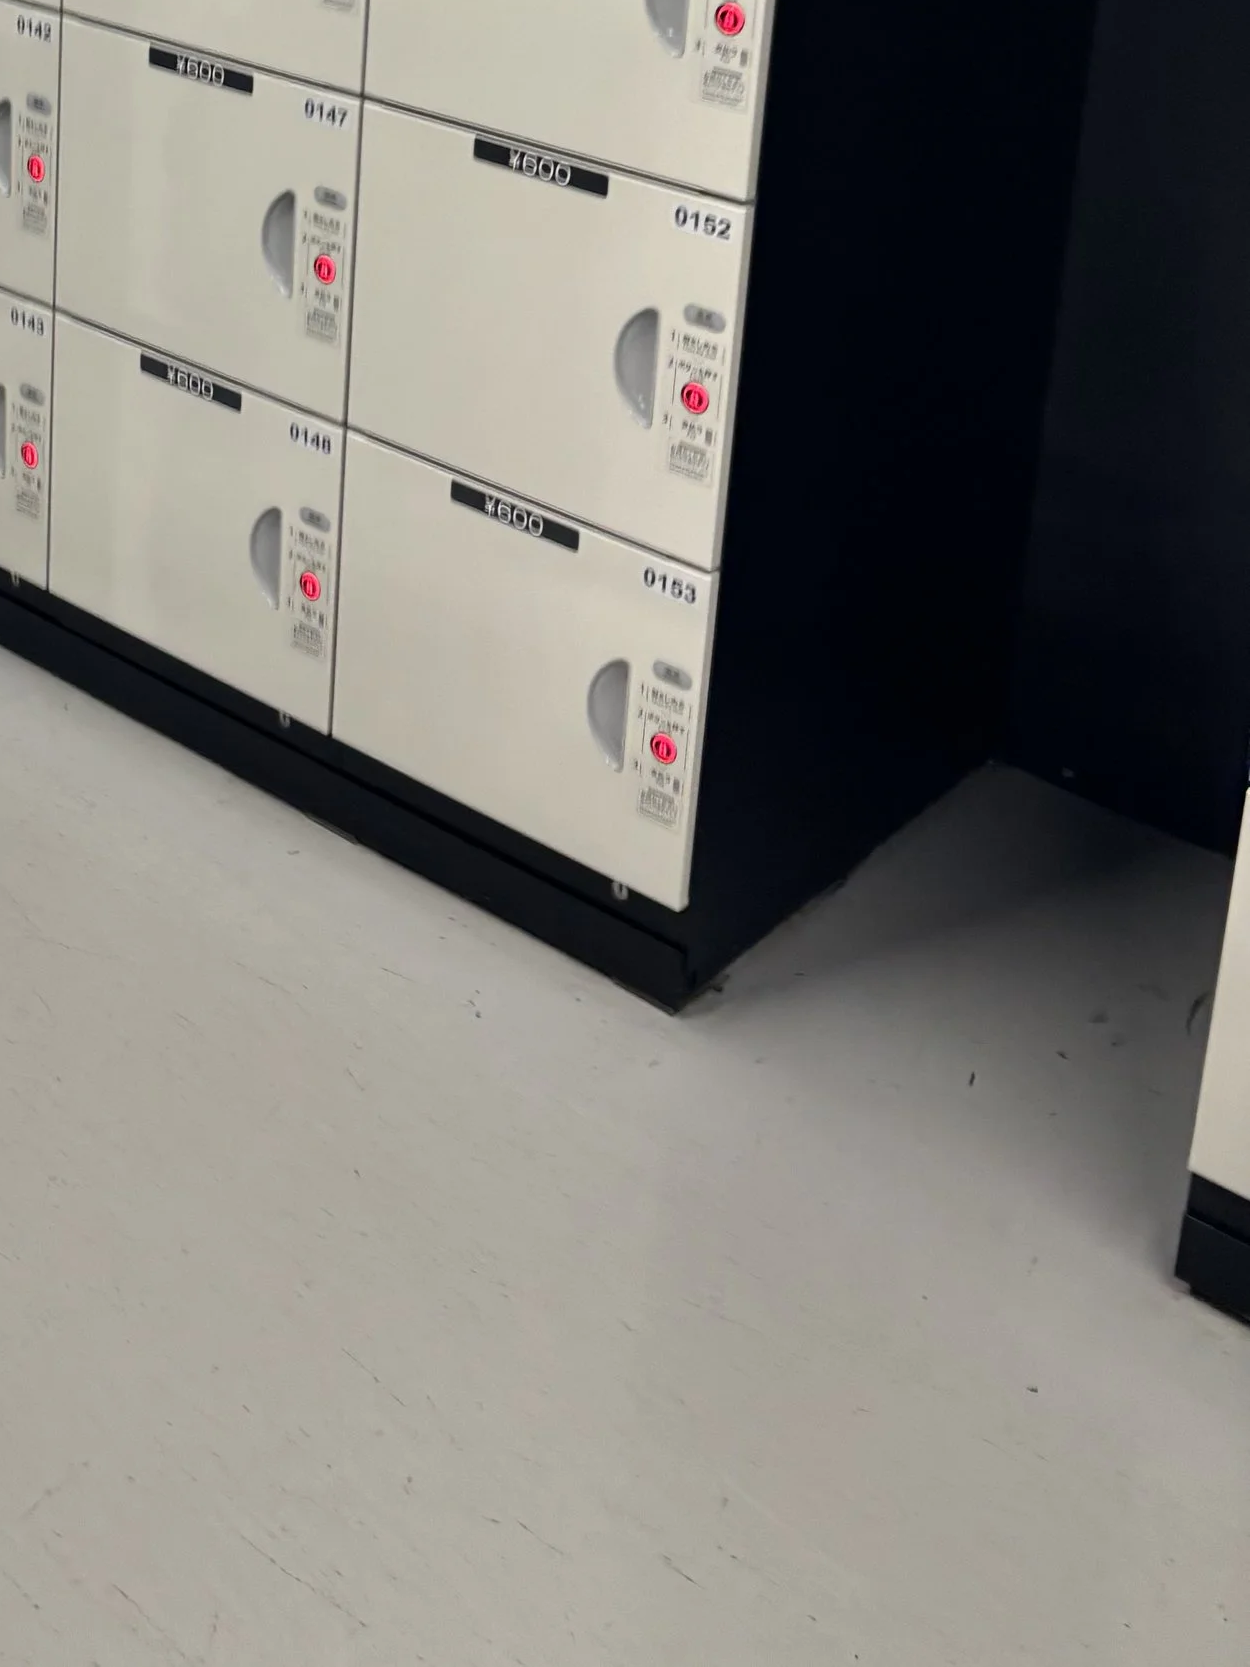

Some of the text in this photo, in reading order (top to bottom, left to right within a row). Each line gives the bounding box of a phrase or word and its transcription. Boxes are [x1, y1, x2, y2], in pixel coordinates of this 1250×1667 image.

[177, 55, 225, 87] ¥600
[304, 98, 347, 127] 0147
[509, 147, 571, 186] ¥600
[674, 205, 731, 240] 0152
[167, 364, 214, 401] ¥600
[485, 495, 544, 537] ¥600
[643, 567, 696, 605] 0153
